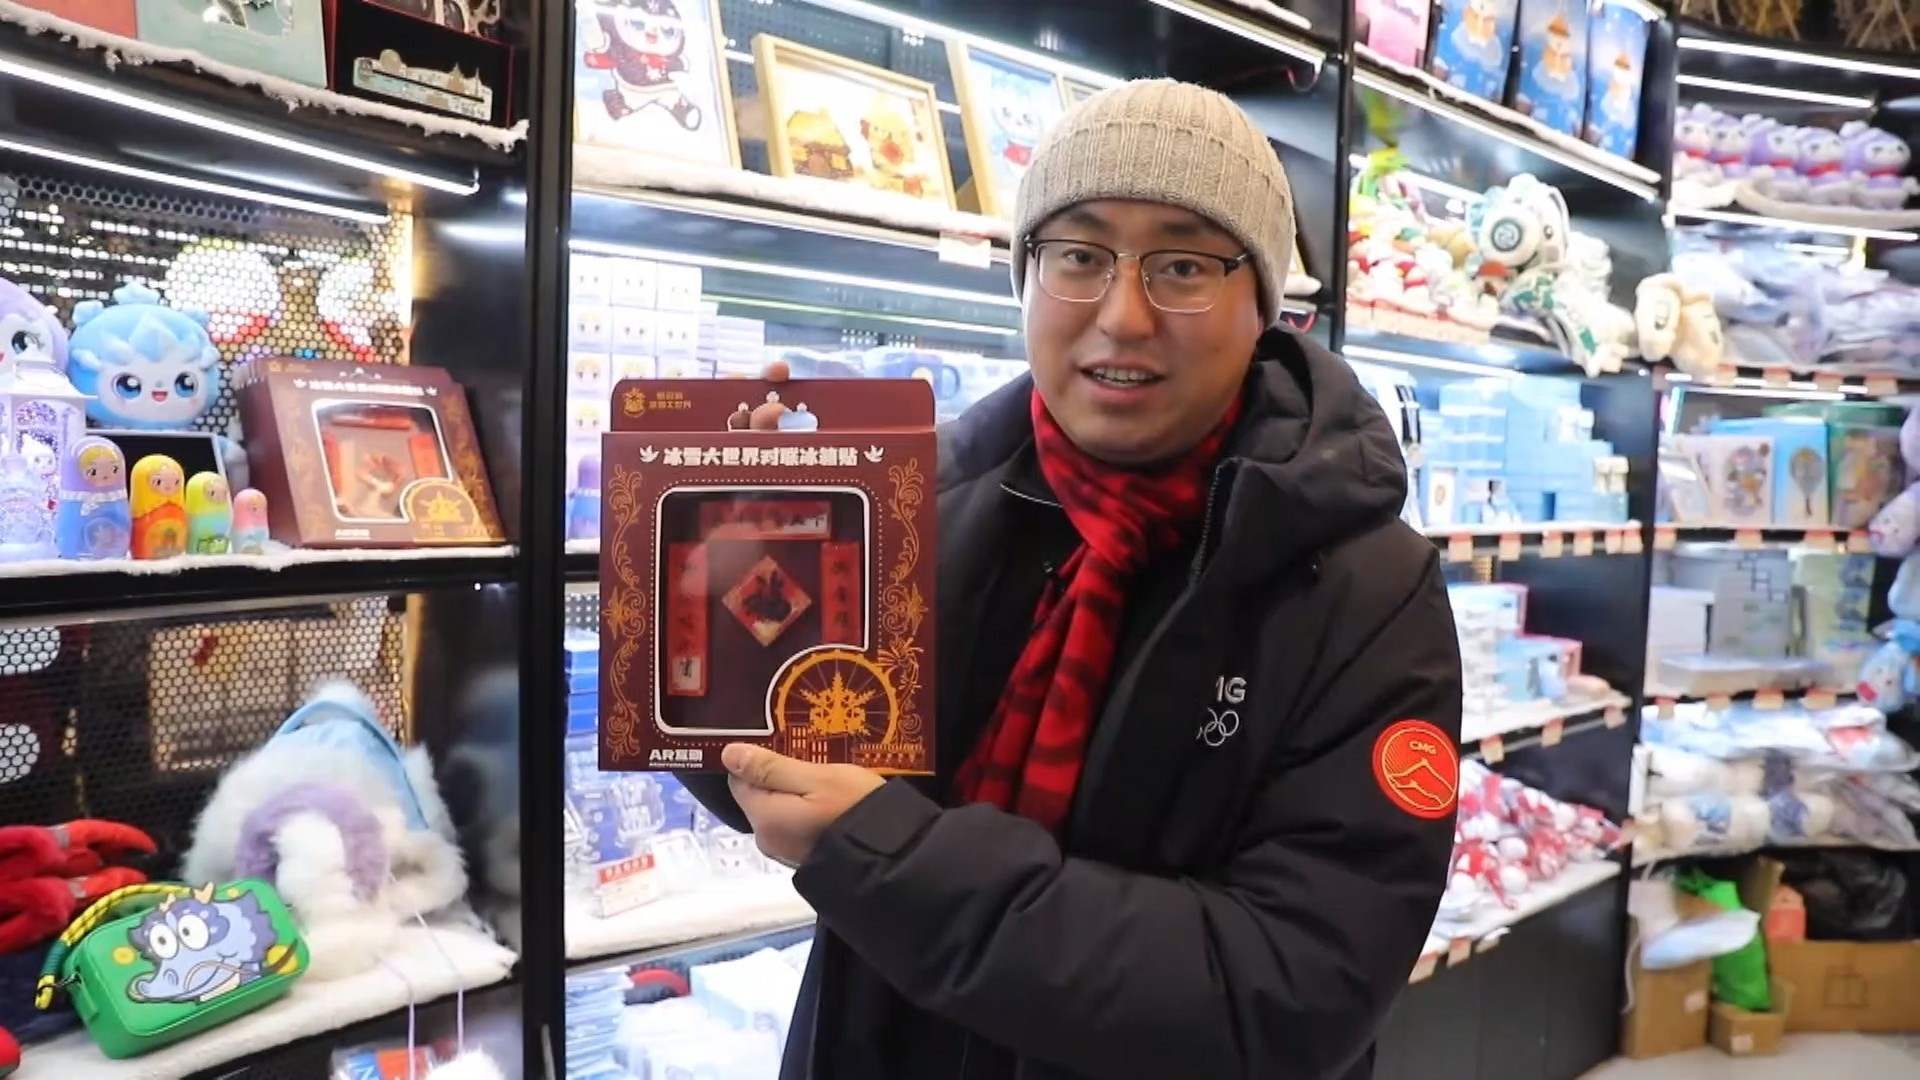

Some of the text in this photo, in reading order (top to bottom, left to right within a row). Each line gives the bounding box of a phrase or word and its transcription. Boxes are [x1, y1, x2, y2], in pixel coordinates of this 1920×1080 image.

[663, 447, 858, 466] 冰雪大世界对联冰箱贴
[1409, 741, 1437, 755] CMG
